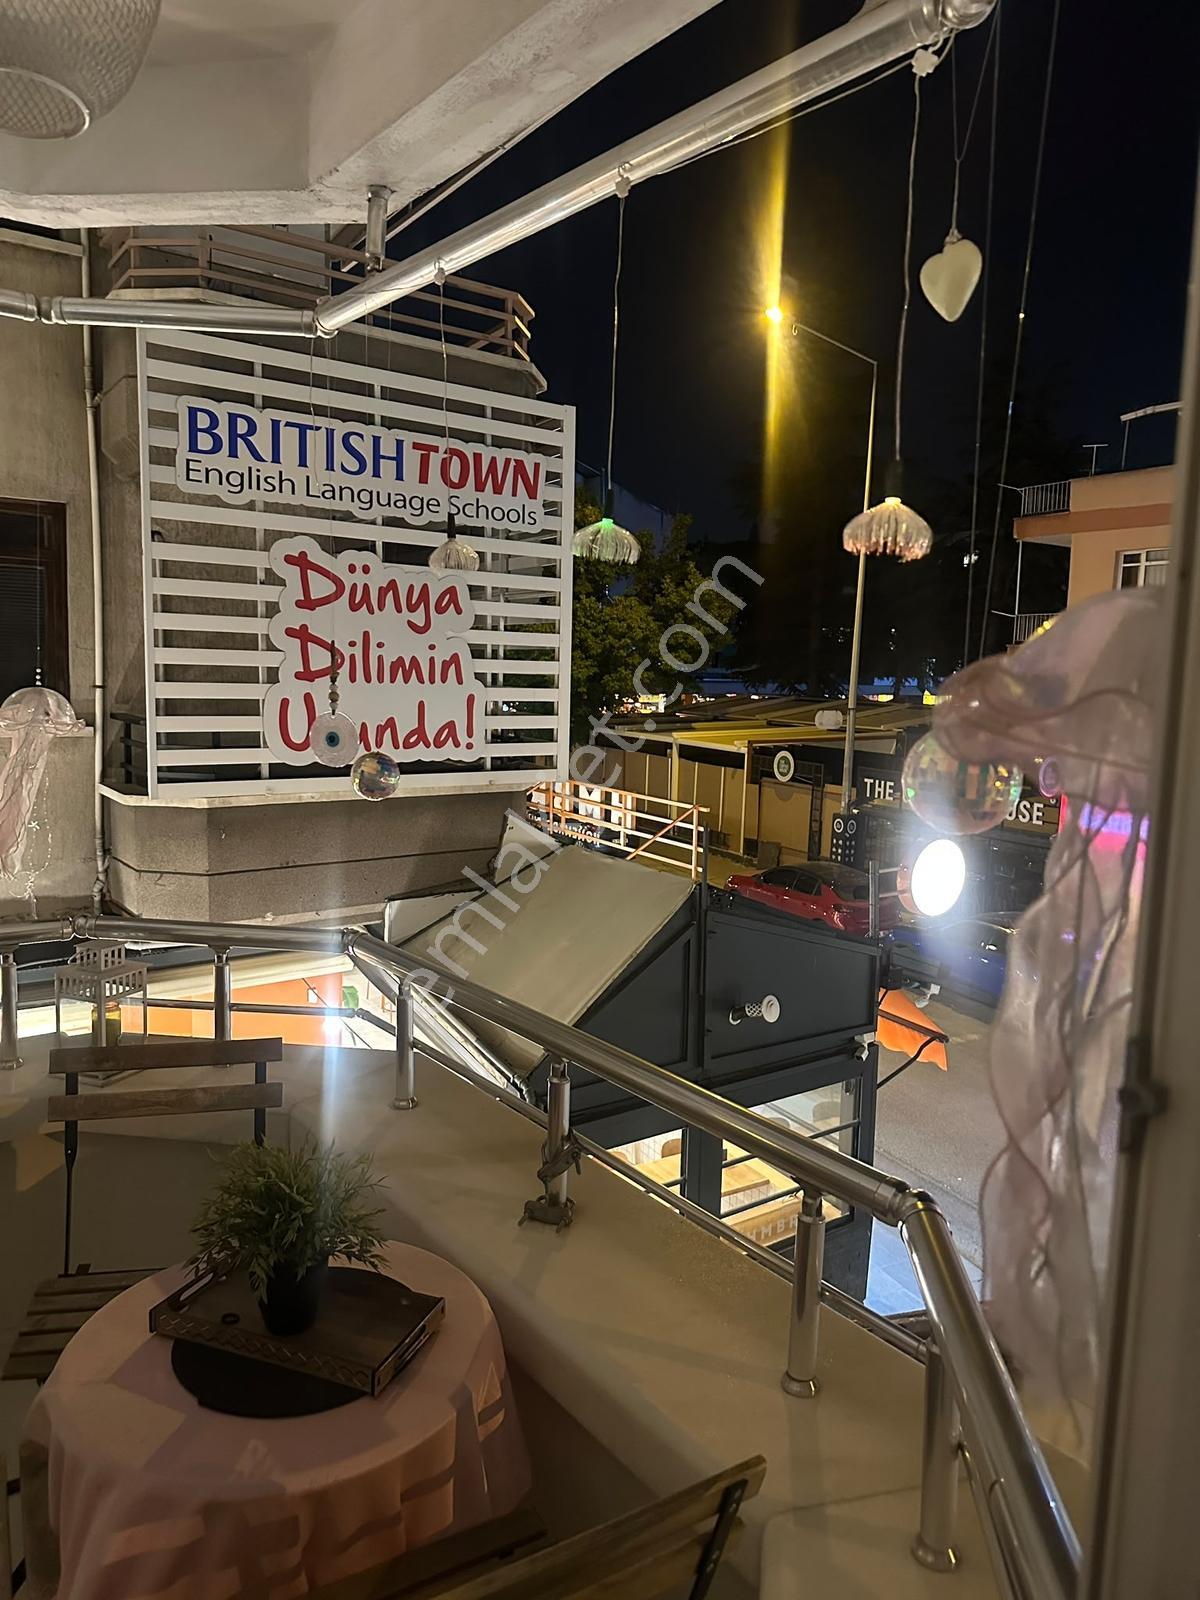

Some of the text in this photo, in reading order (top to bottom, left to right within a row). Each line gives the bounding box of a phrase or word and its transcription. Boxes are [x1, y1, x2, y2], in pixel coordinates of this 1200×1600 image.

[185, 458, 537, 526] English Language Schools
[283, 550, 463, 635] Dünya
[284, 623, 464, 685] Dilimin
[278, 692, 476, 752] Unda!
[864, 778, 895, 801] THE
